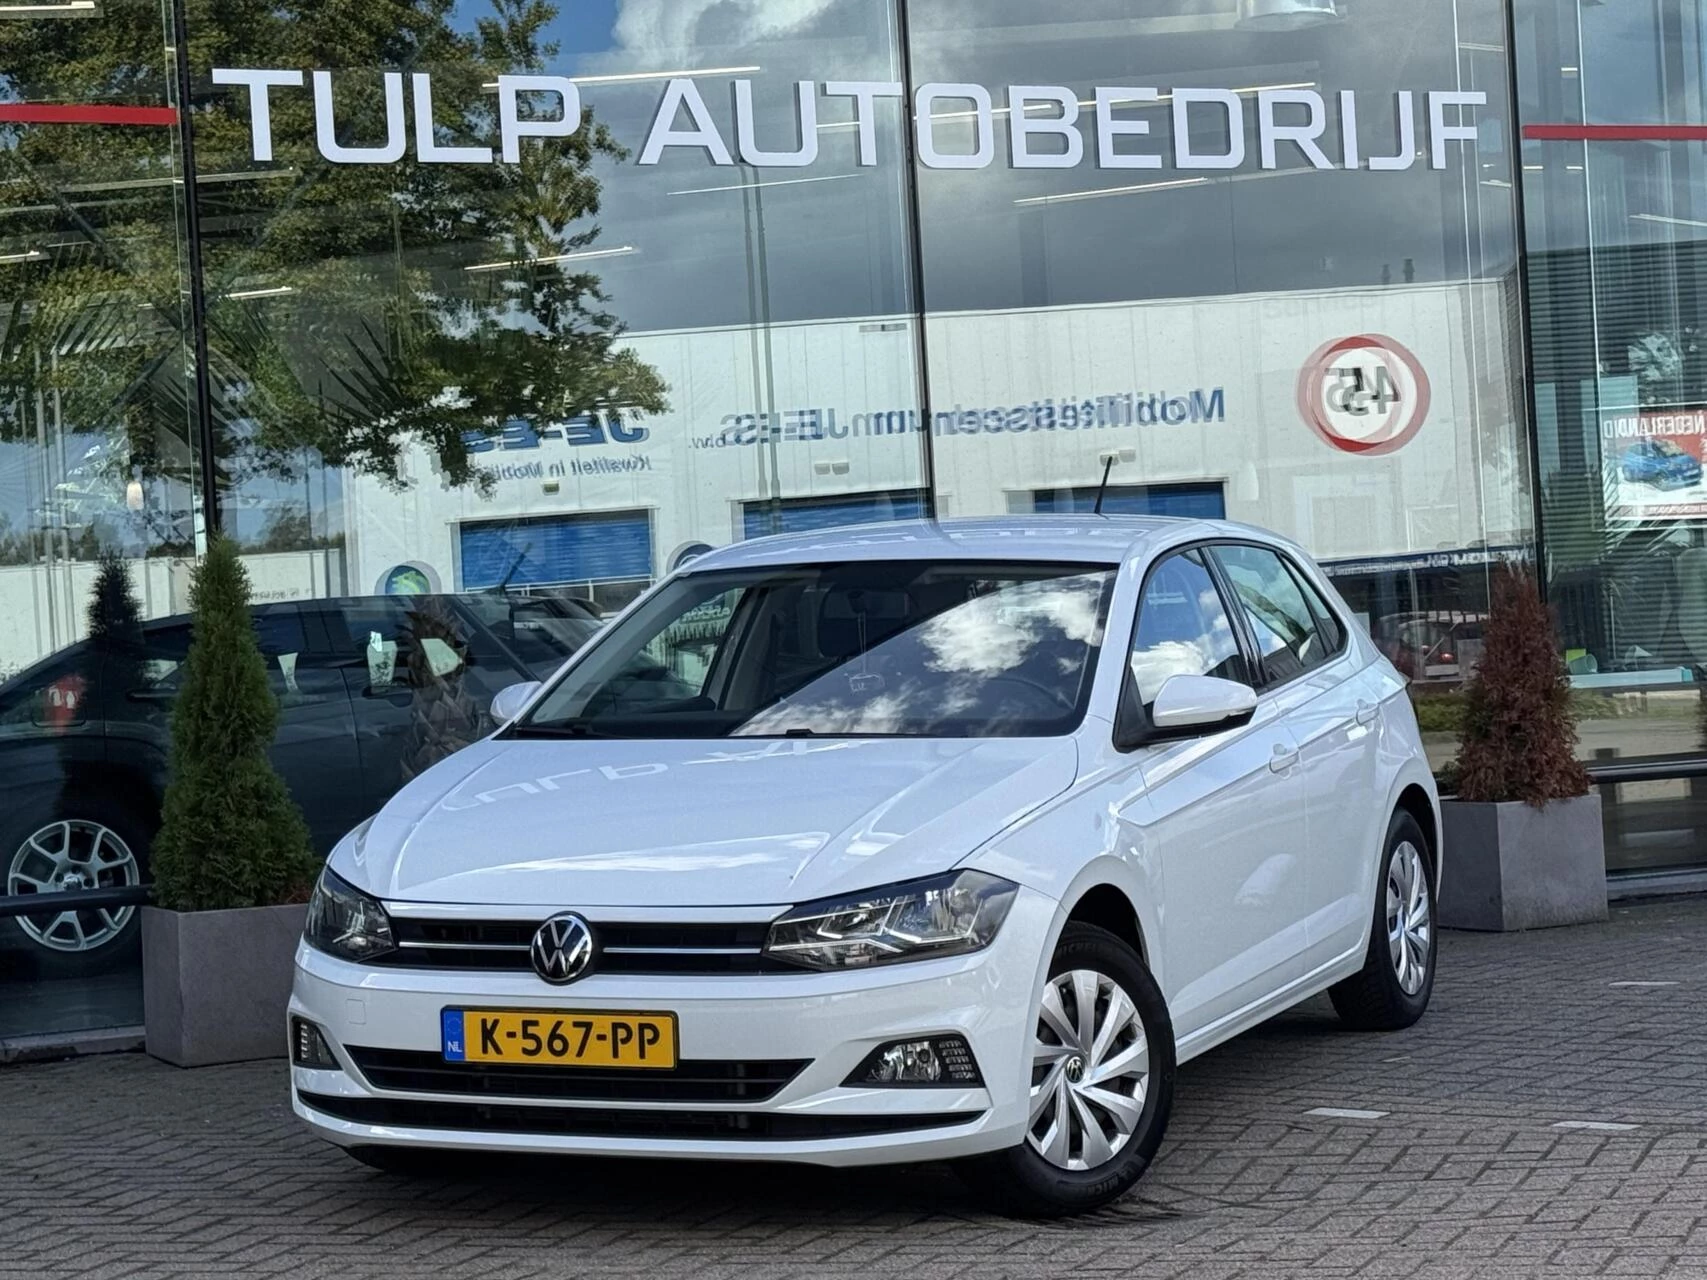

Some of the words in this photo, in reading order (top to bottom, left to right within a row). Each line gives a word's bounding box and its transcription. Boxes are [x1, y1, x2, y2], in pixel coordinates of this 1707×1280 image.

[211, 68, 581, 165] TULP
[638, 78, 1487, 172] AUTOBEDRIJF
[447, 1041, 462, 1053] NL
[480, 1018, 660, 1060] K-567-PP
